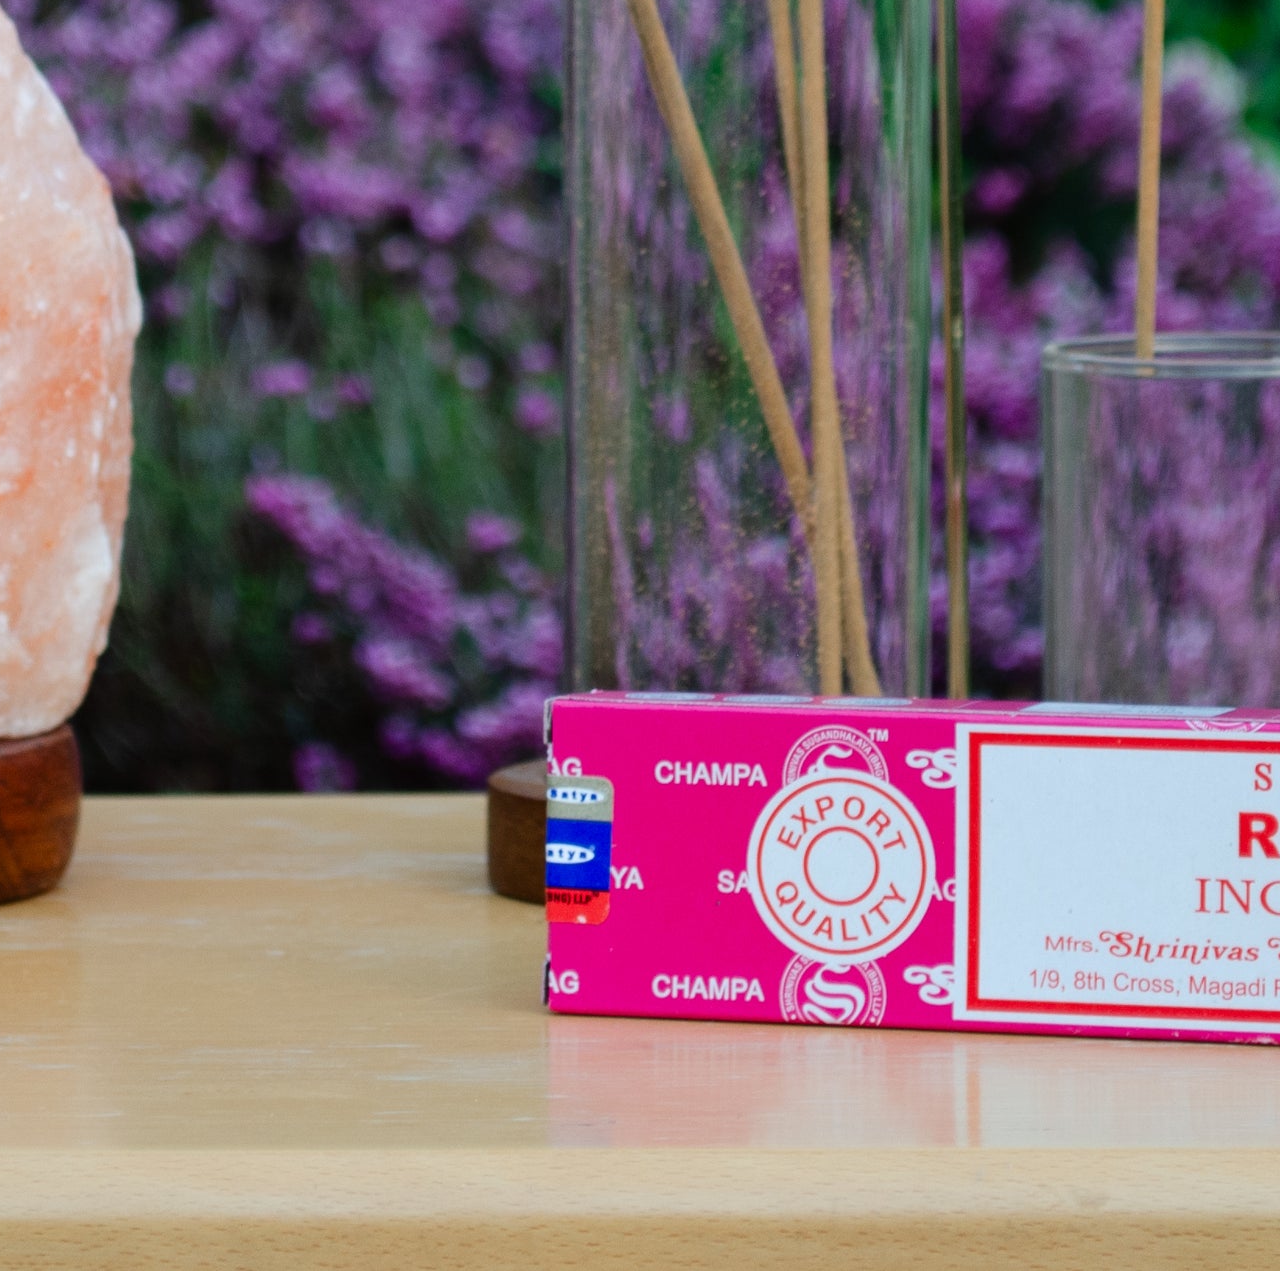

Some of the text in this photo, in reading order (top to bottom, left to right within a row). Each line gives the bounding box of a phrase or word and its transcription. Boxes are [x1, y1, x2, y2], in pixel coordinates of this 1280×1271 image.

[802, 729, 872, 757] SUGANDHALAYA
[867, 729, 889, 742] TM
[655, 760, 768, 788] CHAMPA
[550, 788, 598, 803] Satya
[776, 795, 908, 852] EXPORT
[547, 848, 588, 862] atya
[775, 880, 908, 943] QUALITY
[1045, 935, 1099, 953] Mfrs.
[1099, 930, 1260, 965] Shrinivas
[652, 974, 765, 1002] CHAMPA
[1028, 969, 1066, 992] 1/9,
[1073, 971, 1106, 991] 8th
[1113, 972, 1180, 996] Cross,
[1189, 976, 1266, 1000] Magadi
